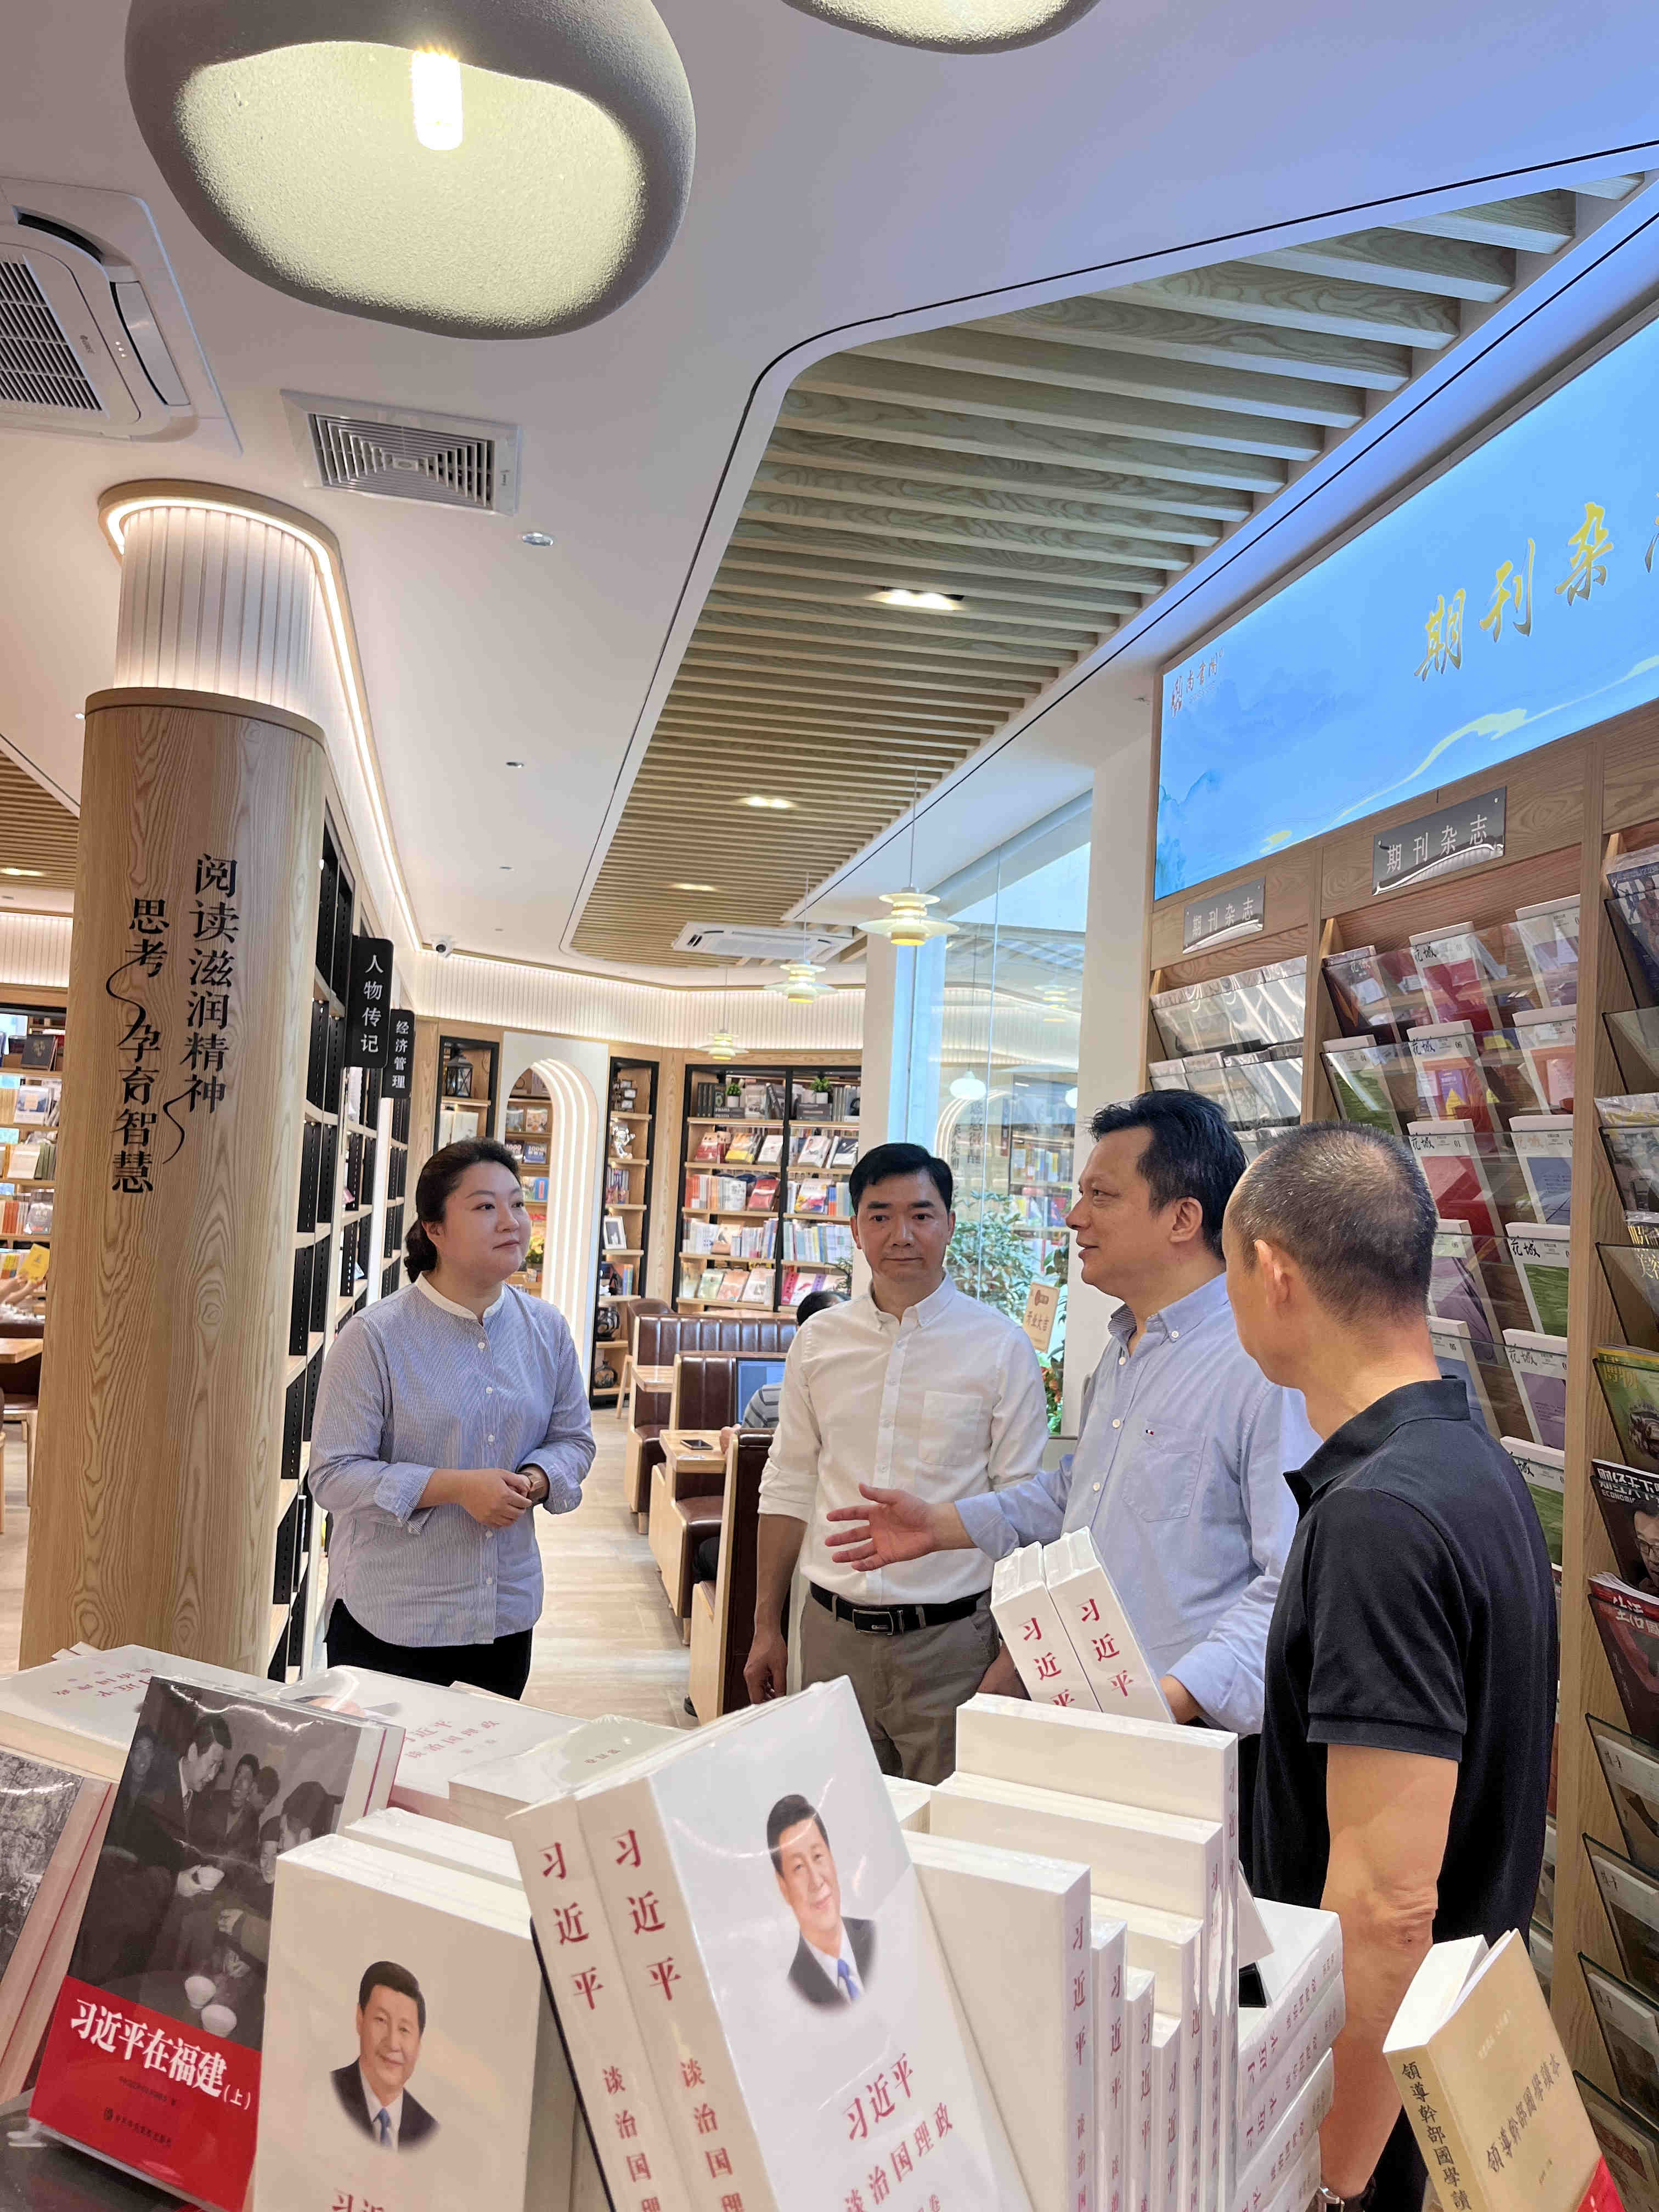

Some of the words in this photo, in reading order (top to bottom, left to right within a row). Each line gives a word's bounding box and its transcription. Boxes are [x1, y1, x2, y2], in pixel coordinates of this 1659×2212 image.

[1386, 814, 1488, 873] 期刊杂志
[1192, 896, 1255, 936] 期刊杂志
[1412, 942, 1437, 962] 花城
[179, 853, 239, 1114] 阅读滋润精神
[360, 955, 384, 1054] 人物传记
[106, 897, 170, 1194] 思考孕育智慧
[391, 1019, 410, 1090] 经济管理
[1411, 1037, 1436, 1055] 花城
[1410, 1132, 1435, 1150] 花城
[1510, 1236, 1541, 1258] 花城
[1508, 1344, 1538, 1366] 花城
[1018, 1617, 1076, 1707] 习近平
[1075, 1598, 1134, 1697] 习近平
[538, 1841, 604, 2010] 习近平
[610, 1829, 681, 2001] 习近平
[1072, 1916, 1086, 2067] 习近平
[1110, 1965, 1122, 2110] 习近平
[842, 2052, 913, 2140] 习近平
[1141, 2012, 1151, 2151] 习近平
[1167, 2062, 1177, 2195] 习近平
[844, 2102, 953, 2212] 谈治国理政
[1401, 2061, 1472, 2212] 領導幹部國學讀
